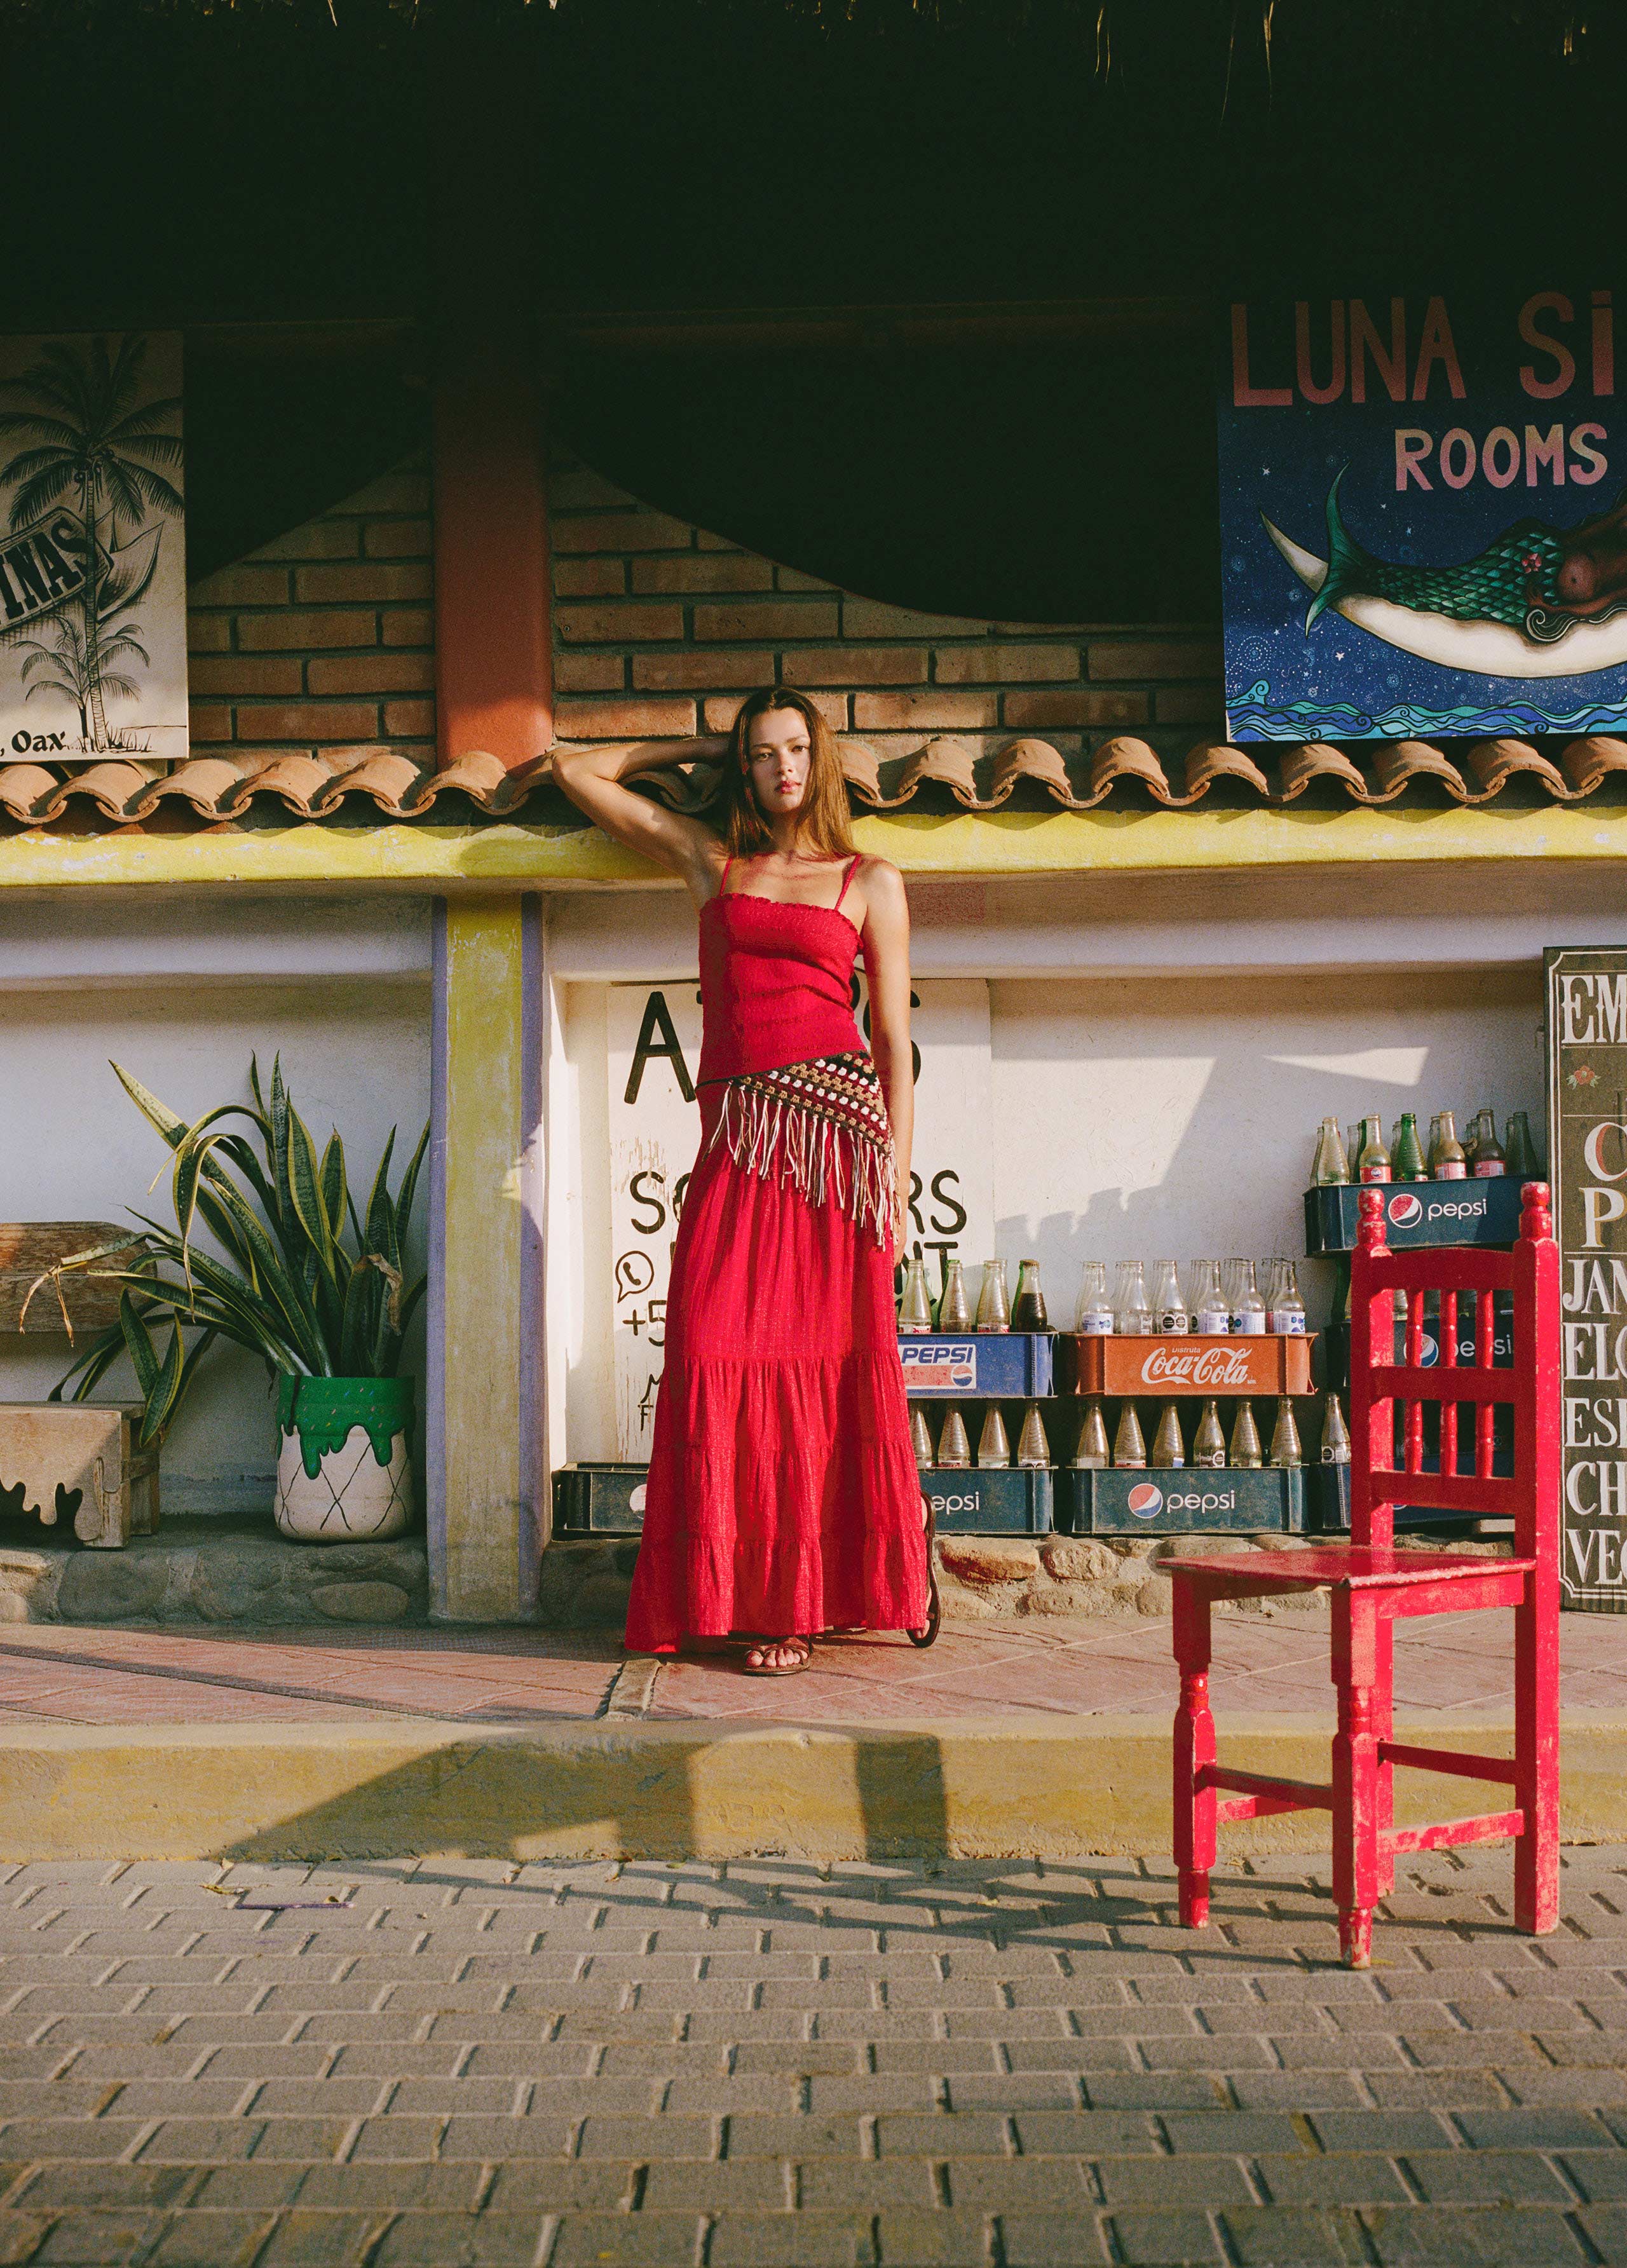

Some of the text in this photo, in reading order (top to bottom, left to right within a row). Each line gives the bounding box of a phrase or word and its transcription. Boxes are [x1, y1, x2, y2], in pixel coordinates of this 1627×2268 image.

[1231, 295, 1467, 407] LUNA
[1395, 423, 1608, 491] ROOMS
[1561, 975, 1627, 1043] EM
[1427, 1198, 1487, 1221] pepsi
[901, 1347, 974, 1364] PEPSI
[1141, 1347, 1253, 1385] Coca-Cola
[932, 1491, 980, 1515] epsi
[1167, 1489, 1236, 1514] pepsi
[1565, 1528, 1627, 1585] VE
